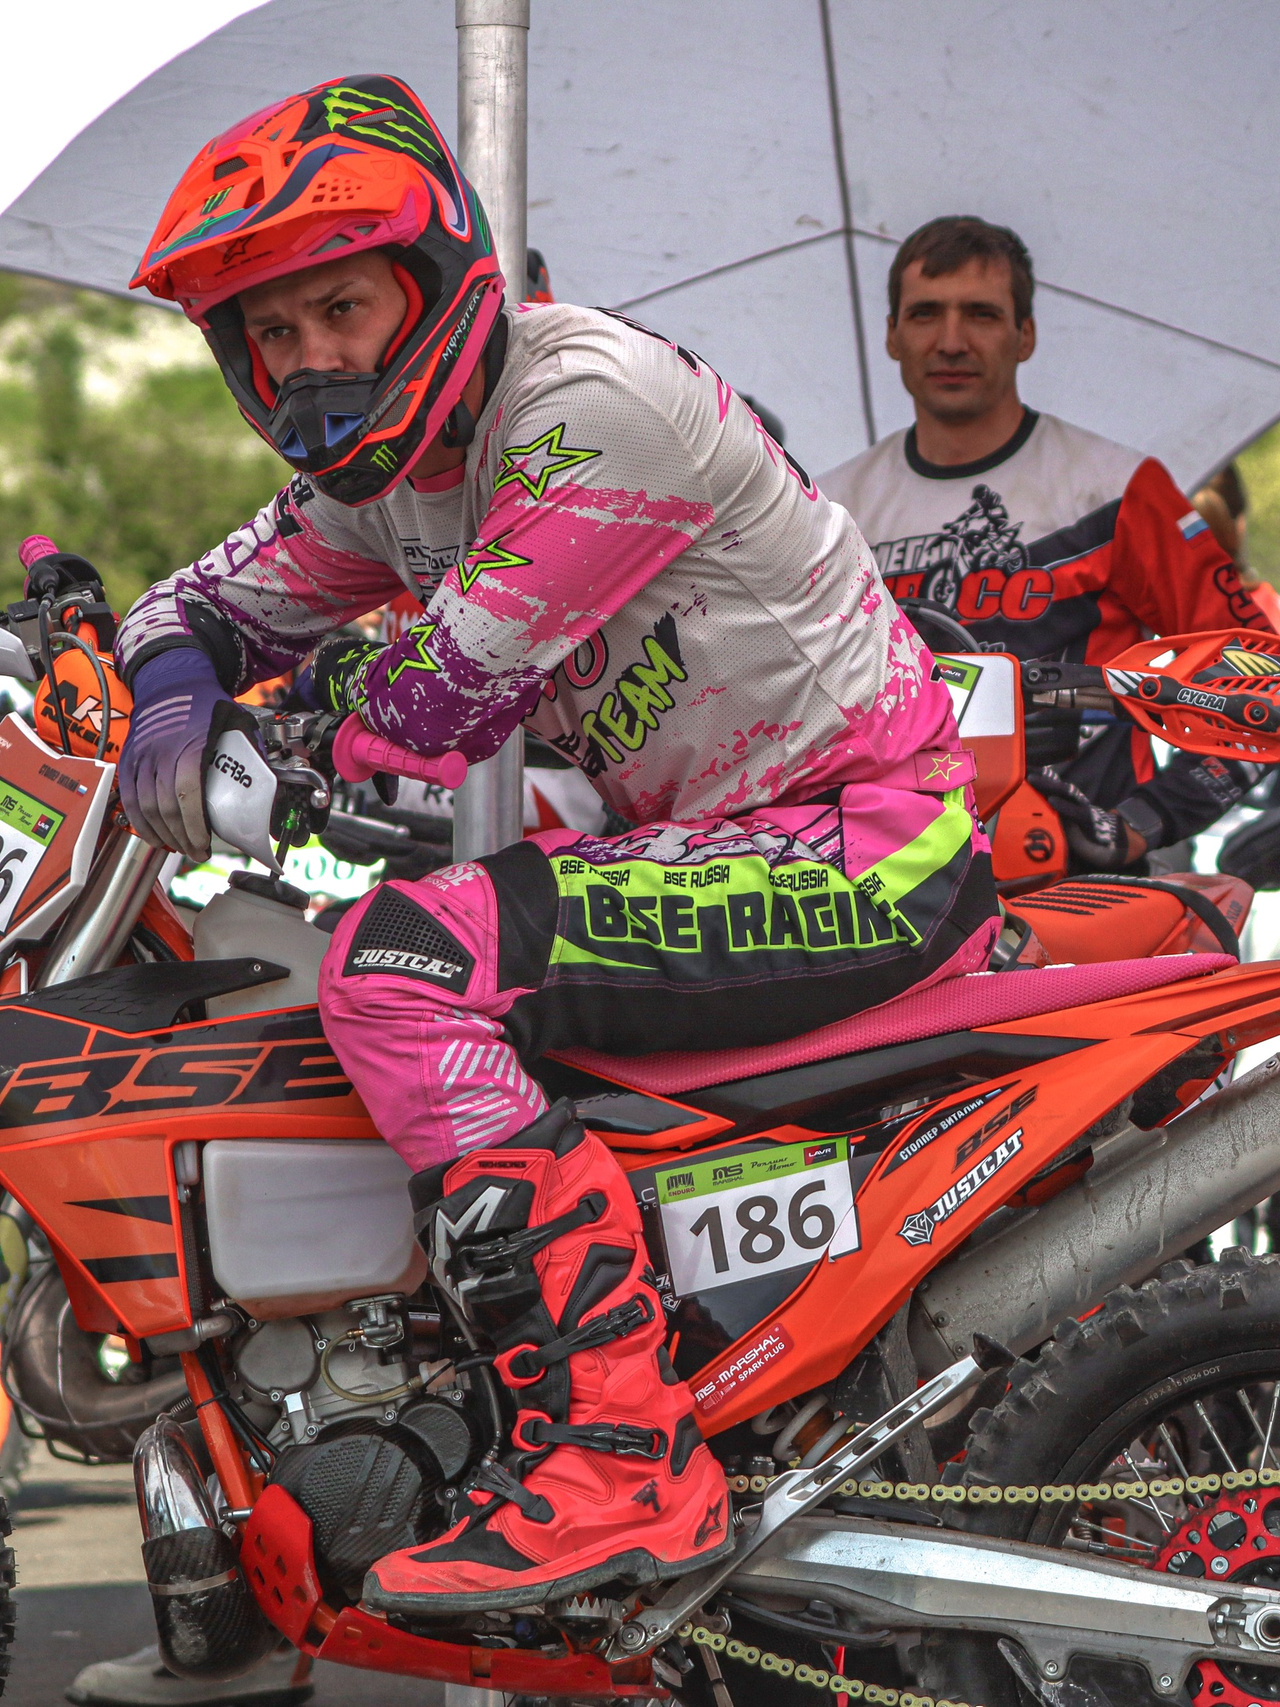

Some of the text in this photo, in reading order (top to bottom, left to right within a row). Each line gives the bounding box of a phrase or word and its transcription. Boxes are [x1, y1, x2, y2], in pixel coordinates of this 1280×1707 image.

[580, 634, 688, 764] TEAM
[1177, 687, 1227, 712] CYCRA
[560, 860, 585, 874] BSE
[664, 865, 730, 888] BSE RUSSIA
[586, 884, 701, 953] BSE
[353, 949, 464, 979] JUSTCAT
[0, 1043, 354, 1129] BSE
[899, 1126, 939, 1161] СТОЛПЕР
[939, 1098, 984, 1130] ВИТАЛИЙ
[953, 1083, 1039, 1170] BSE
[808, 1147, 832, 1158] LAVR
[668, 1186, 696, 1197] ENDURO
[929, 1127, 1024, 1222] JUSTCAT
[689, 1179, 836, 1274] 186
[737, 1341, 785, 1382] SPARK PLUG
[1202, 1365, 1220, 1377] DOT
